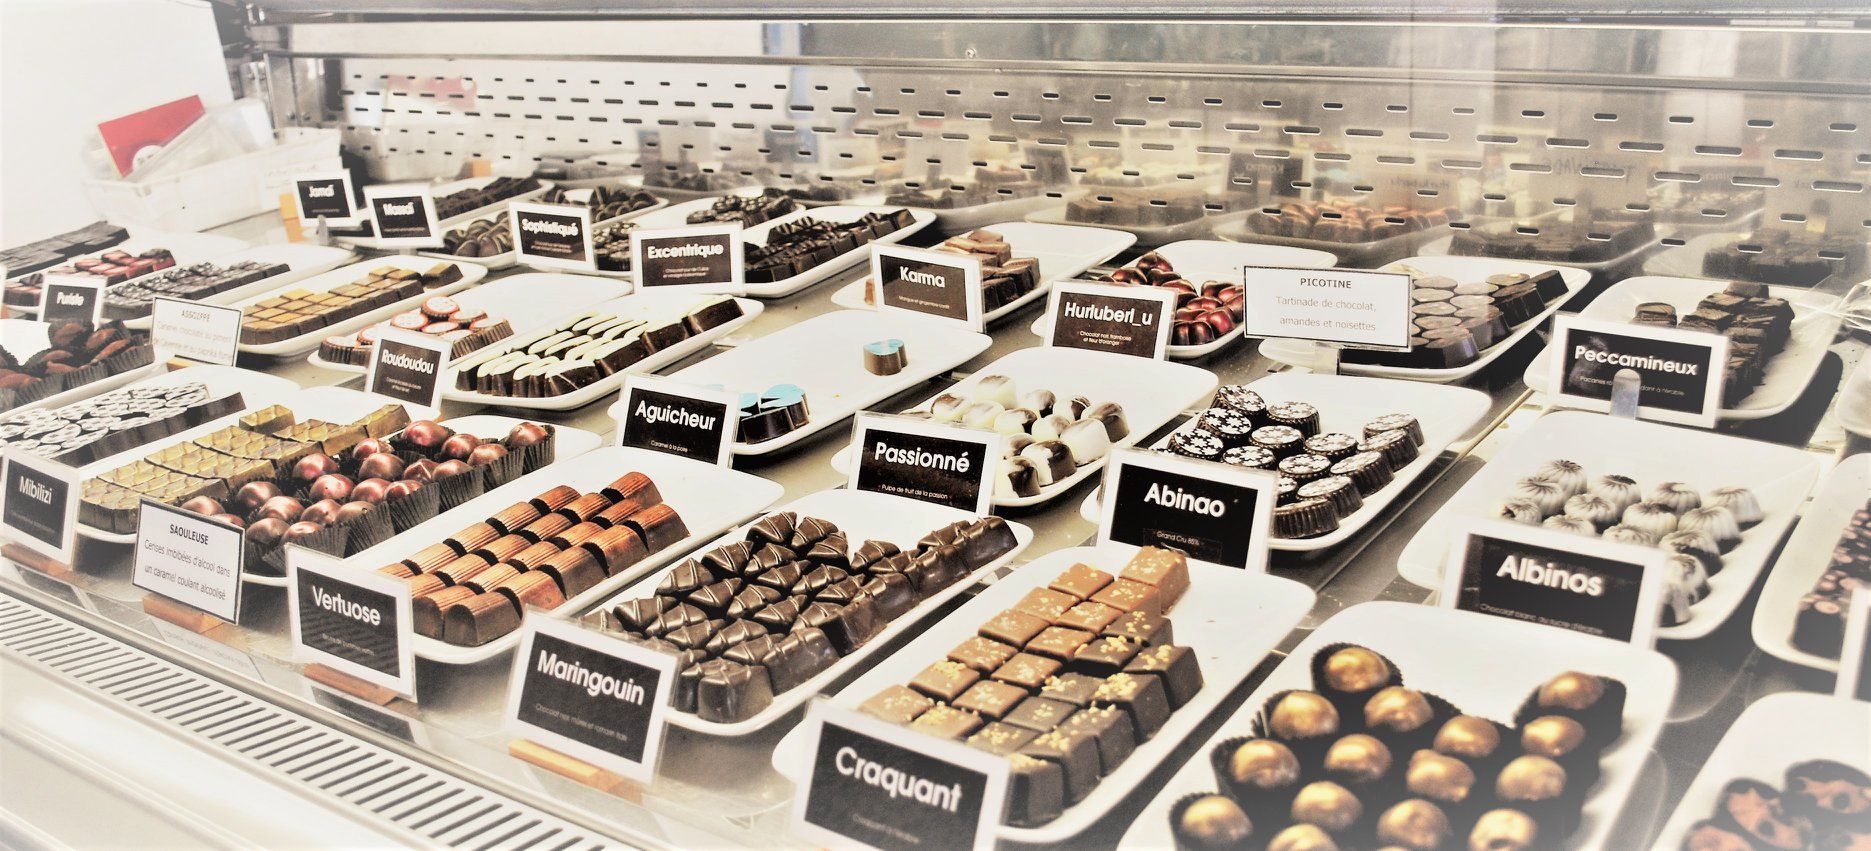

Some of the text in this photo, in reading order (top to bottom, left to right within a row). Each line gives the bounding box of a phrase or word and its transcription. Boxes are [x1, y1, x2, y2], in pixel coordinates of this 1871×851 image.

[647, 243, 724, 259] Excentrique
[899, 265, 946, 288] Karma
[1300, 277, 1352, 289] PICOTINE
[1064, 301, 1153, 327] Hurluberl_u
[1276, 295, 1377, 313] Tartinade de chocolat,
[1279, 316, 1376, 332] amandes et noisettes
[381, 349, 434, 374] Roudoudou
[1574, 345, 1698, 375] Peccamineux
[635, 400, 716, 430] Aguicheur
[874, 441, 970, 473] Passionné
[19, 476, 53, 504] Mibilizi
[882, 484, 896, 492] Pulpe
[929, 492, 948, 500] passion
[1143, 482, 1226, 518] Abinao
[169, 523, 209, 545] SAOULEUSE
[1156, 530, 1176, 540] Grand
[1176, 535, 1187, 543] Cru
[153, 567, 177, 582] caramel
[177, 575, 200, 591] coulant
[216, 564, 231, 578] dans
[1496, 554, 1603, 597] Albinos
[312, 585, 381, 626] Vertuose
[537, 649, 645, 706] Maringouin
[835, 746, 963, 813] Craquant
